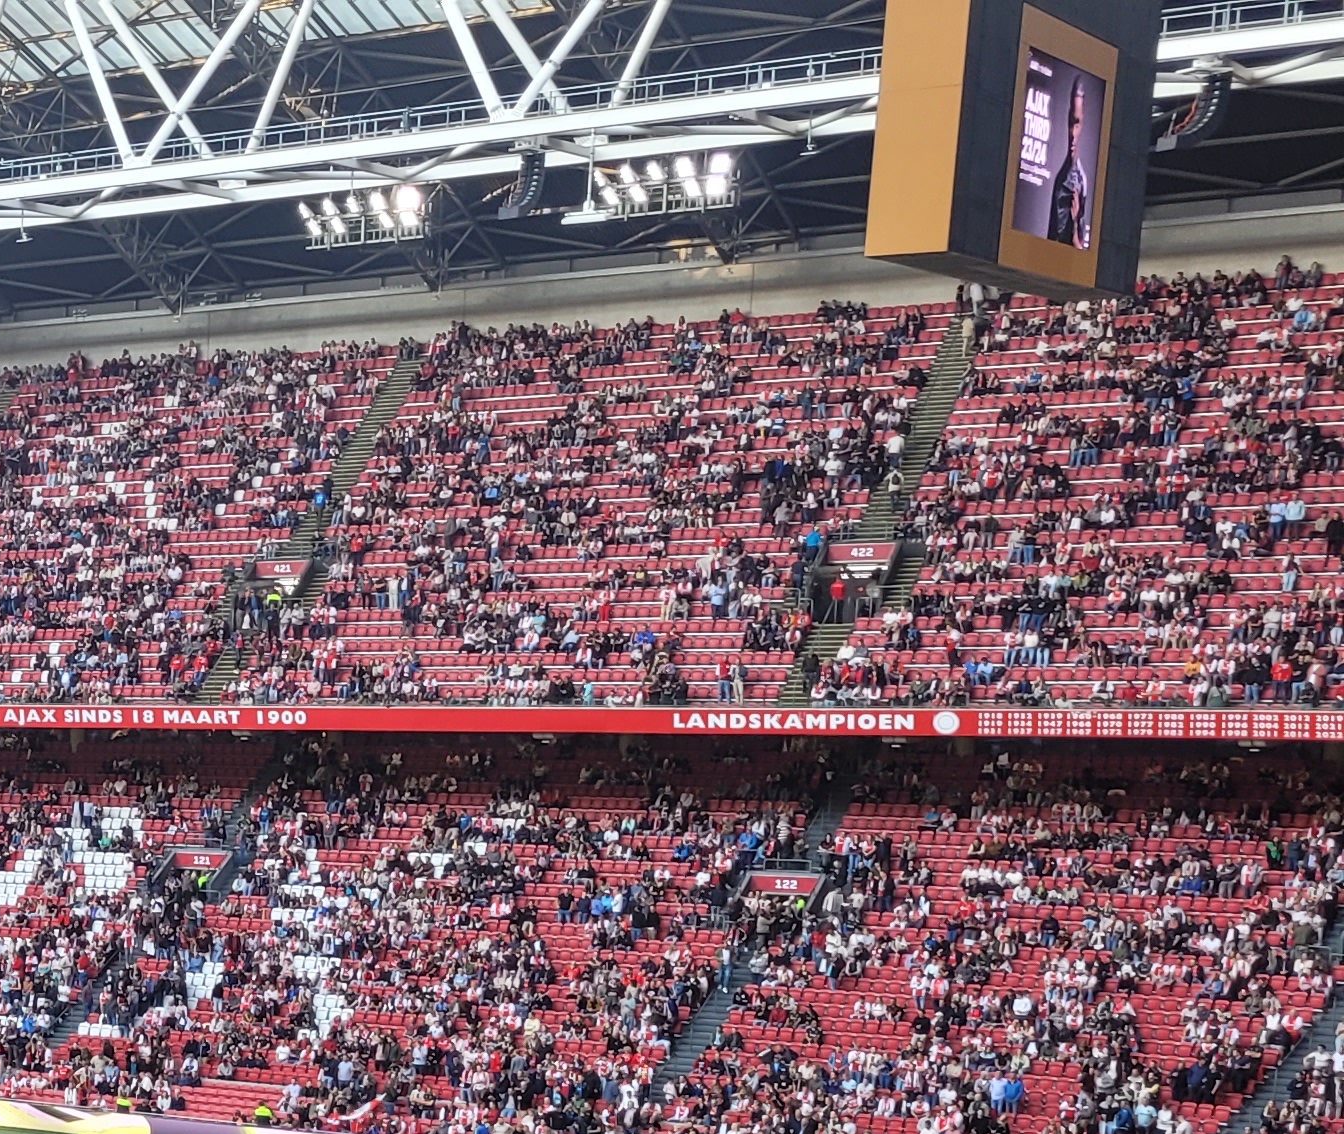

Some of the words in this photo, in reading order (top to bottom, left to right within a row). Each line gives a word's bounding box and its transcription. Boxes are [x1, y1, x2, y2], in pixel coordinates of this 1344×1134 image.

[1025, 87, 1051, 118] AJAX
[1024, 111, 1051, 142] THIRD
[850, 547, 874, 557] 422
[273, 564, 292, 573] 421
[4, 709, 57, 725] AJAX
[64, 709, 123, 724] SINDS
[132, 710, 155, 724] 18
[163, 710, 240, 725] MAART
[257, 710, 307, 725] 1900
[672, 712, 916, 730] LANDSKAMPIOEN
[193, 856, 211, 865] 121
[774, 879, 798, 889] 122
